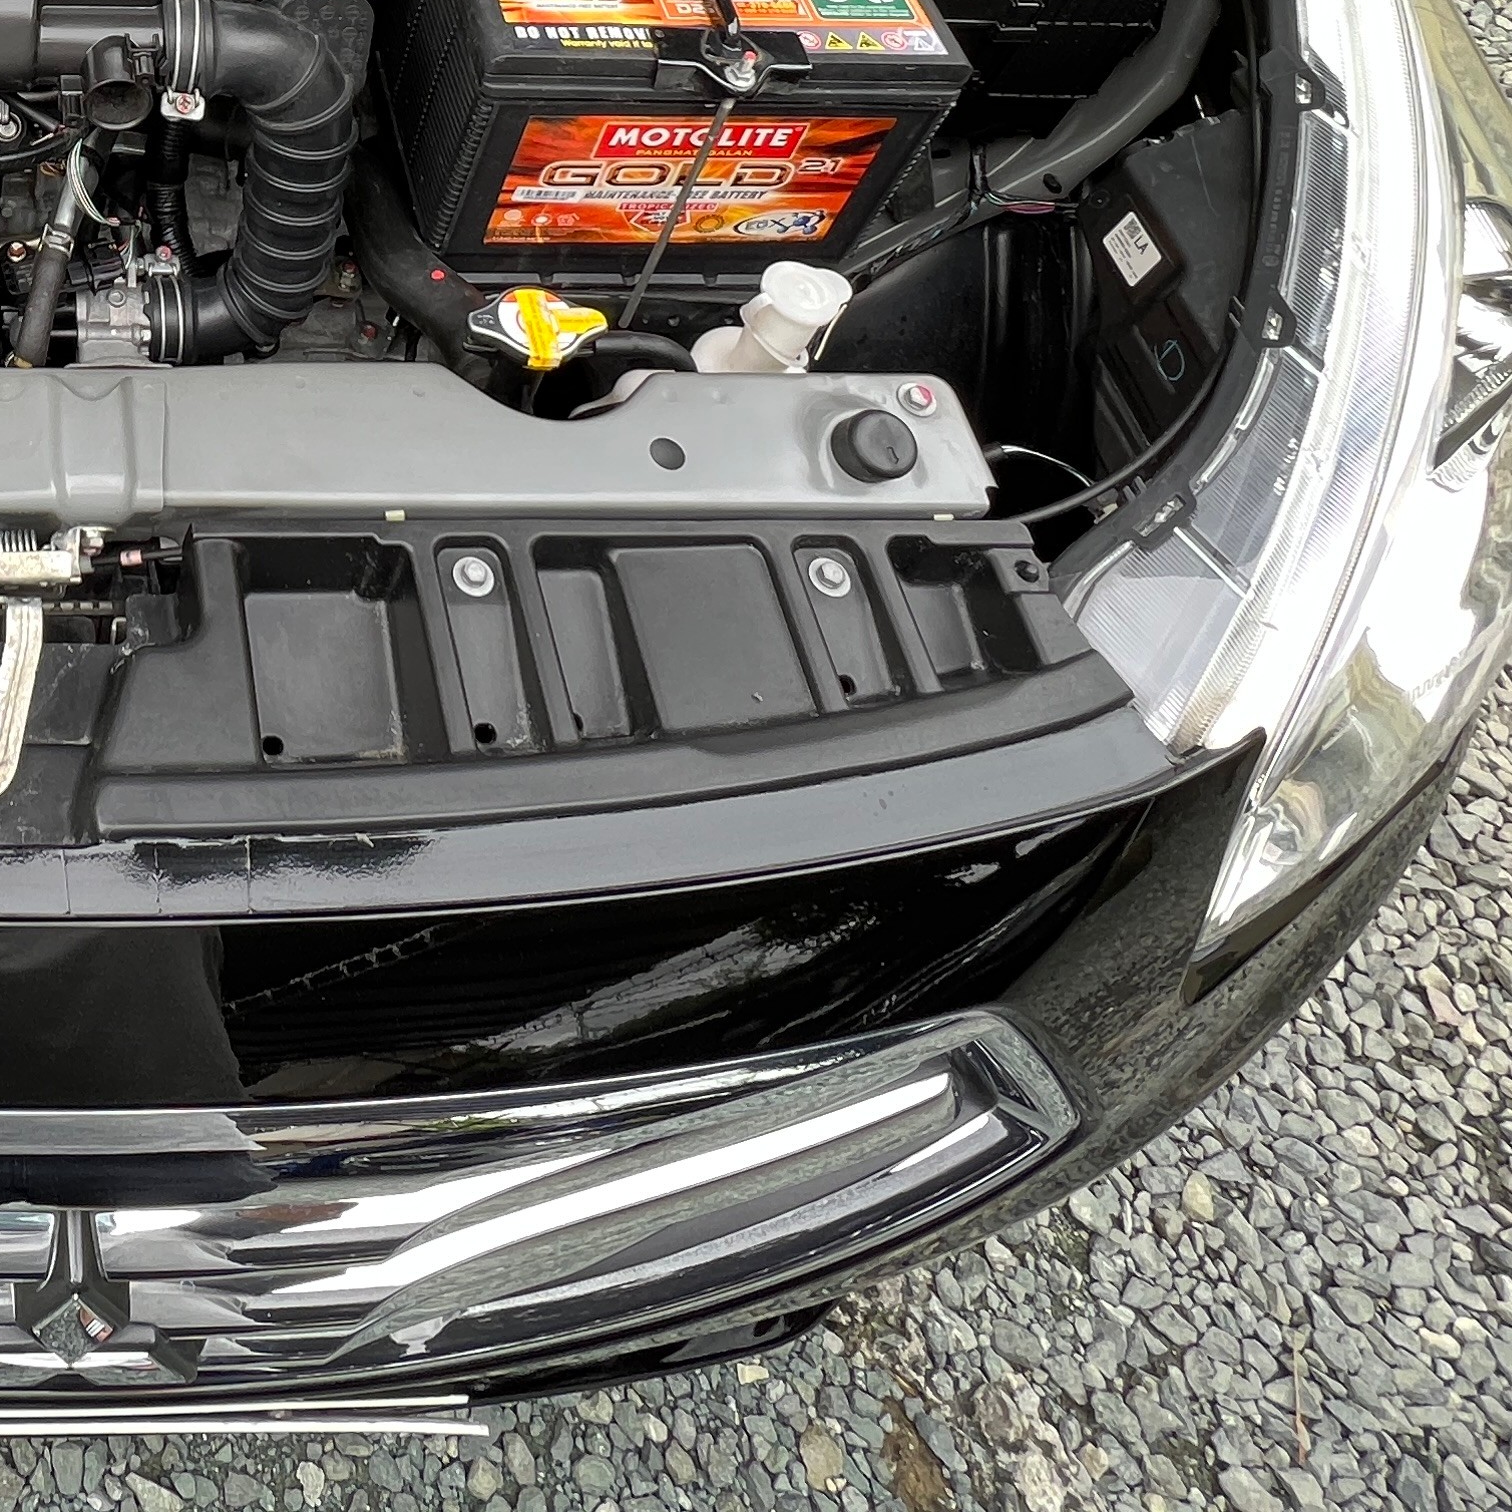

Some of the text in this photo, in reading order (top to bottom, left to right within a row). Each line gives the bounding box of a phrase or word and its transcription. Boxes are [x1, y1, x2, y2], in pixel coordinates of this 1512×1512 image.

[514, 26, 541, 39] DO
[545, 26, 580, 39] NOT
[560, 39, 608, 49] Warranty
[608, 40, 633, 48] void
[542, 162, 791, 187] GOLD
[710, 190, 768, 200] BATTERY
[1133, 235, 1149, 255] LA
